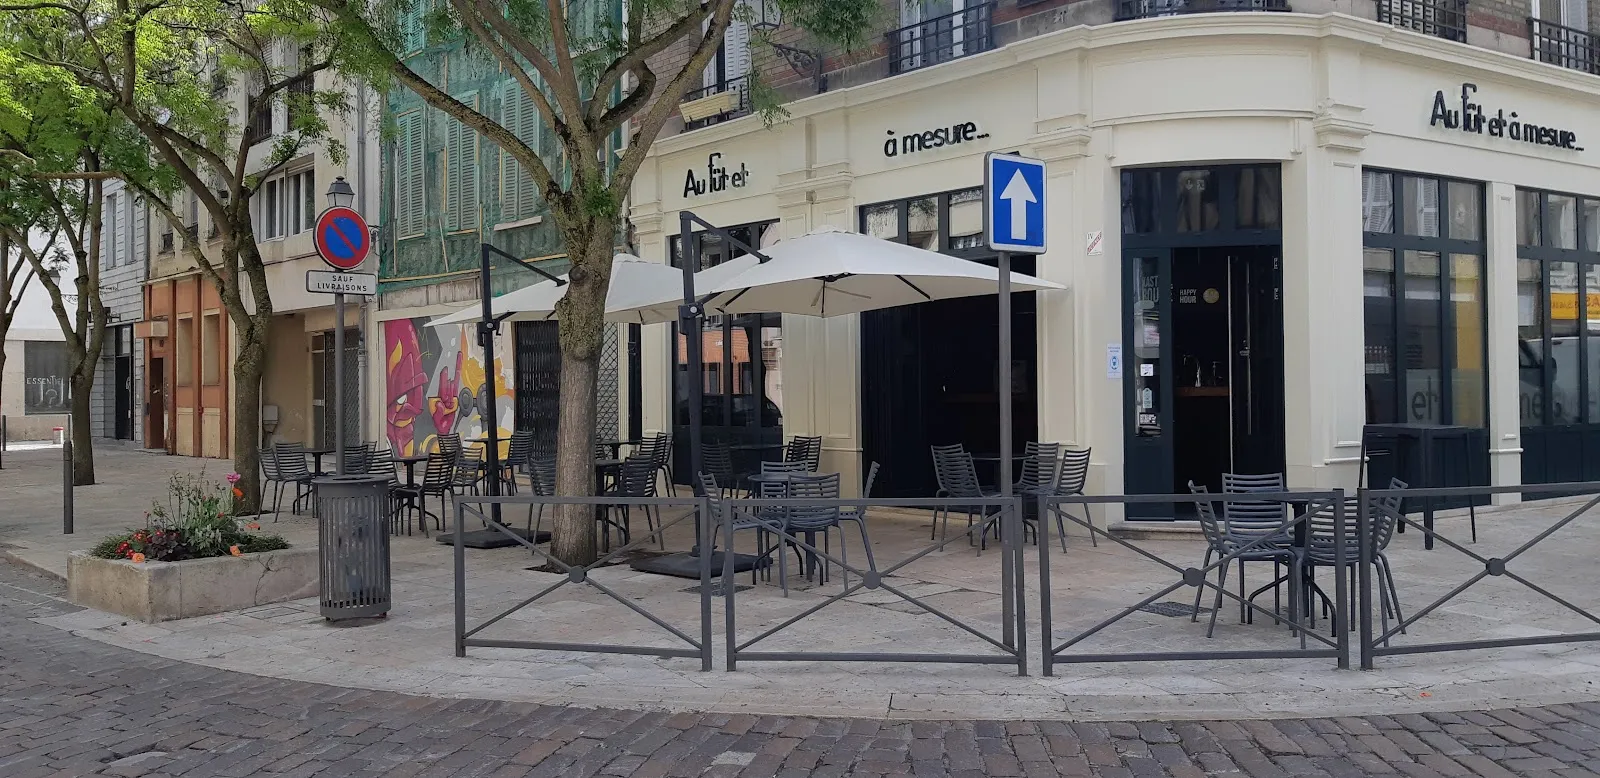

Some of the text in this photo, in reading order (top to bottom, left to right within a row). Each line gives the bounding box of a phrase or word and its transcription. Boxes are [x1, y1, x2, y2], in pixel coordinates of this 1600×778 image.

[1430, 90, 1459, 129] Au
[1461, 82, 1486, 134] fût
[1488, 109, 1507, 137] et
[1509, 112, 1521, 140] à
[884, 130, 897, 157] à
[684, 152, 749, 198] Au fût et
[317, 282, 367, 292] LIVRAISONS
[1180, 296, 1197, 304] HOUR
[1412, 375, 1438, 420] et
